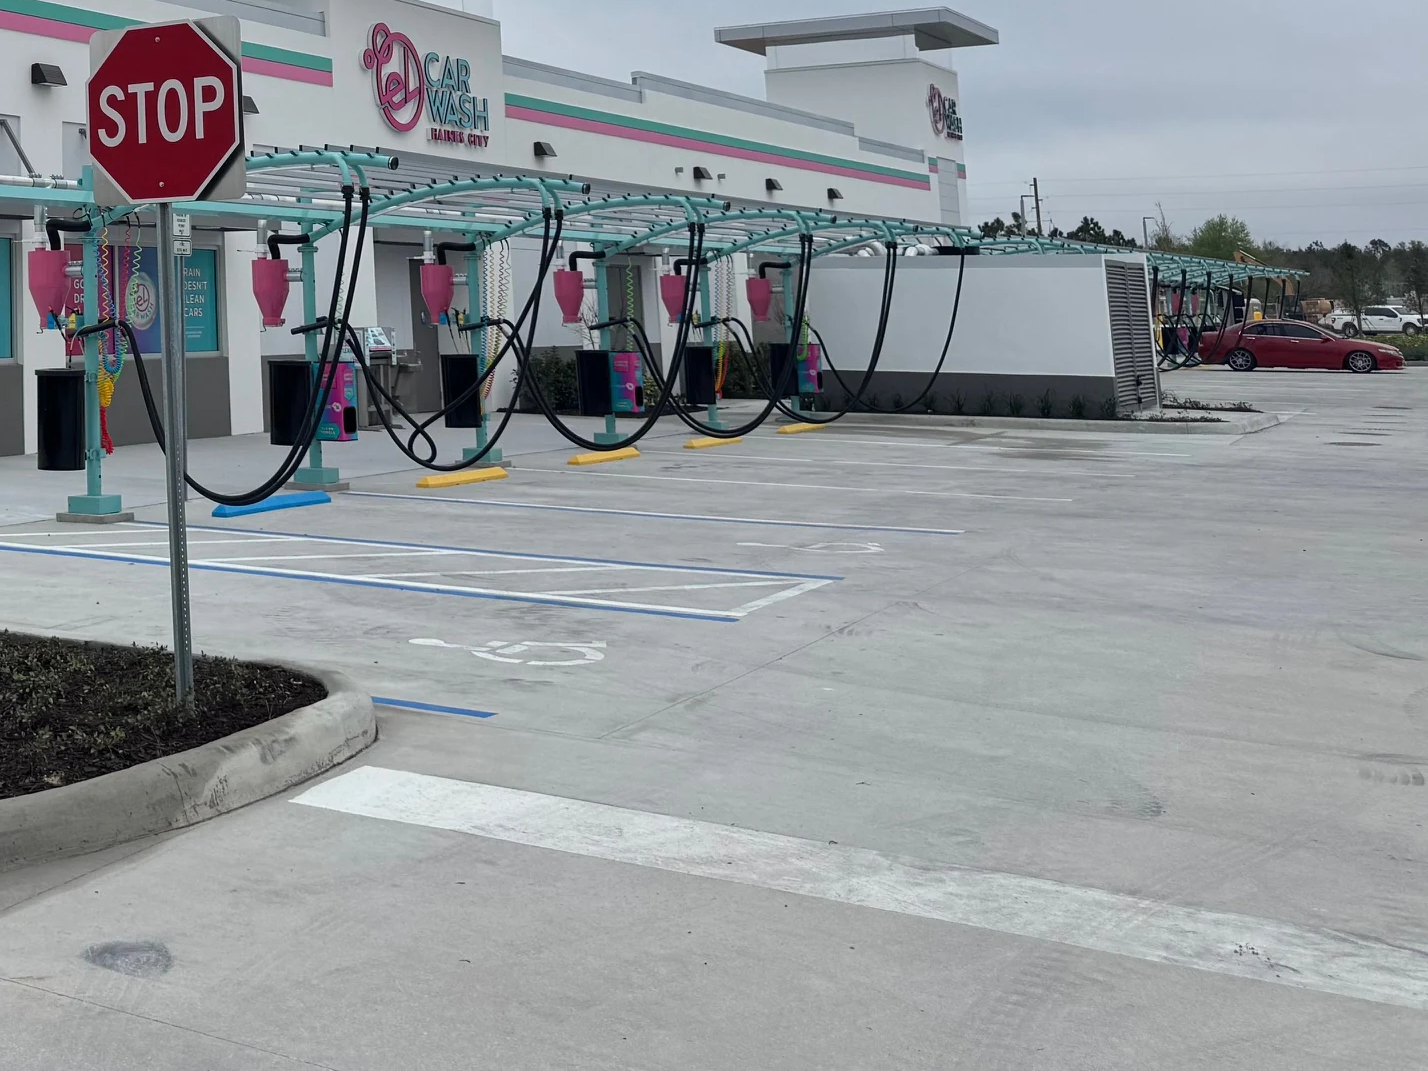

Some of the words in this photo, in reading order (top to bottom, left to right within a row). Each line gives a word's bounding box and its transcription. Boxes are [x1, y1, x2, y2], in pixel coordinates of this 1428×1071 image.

[424, 51, 471, 94] CAR
[97, 75, 225, 148] STOP
[427, 88, 490, 132] WASH
[431, 127, 465, 145] HAINES
[467, 134, 490, 148] CITY
[183, 267, 201, 277] RAIN
[184, 294, 205, 304] LEAN
[183, 308, 203, 317] CARS
